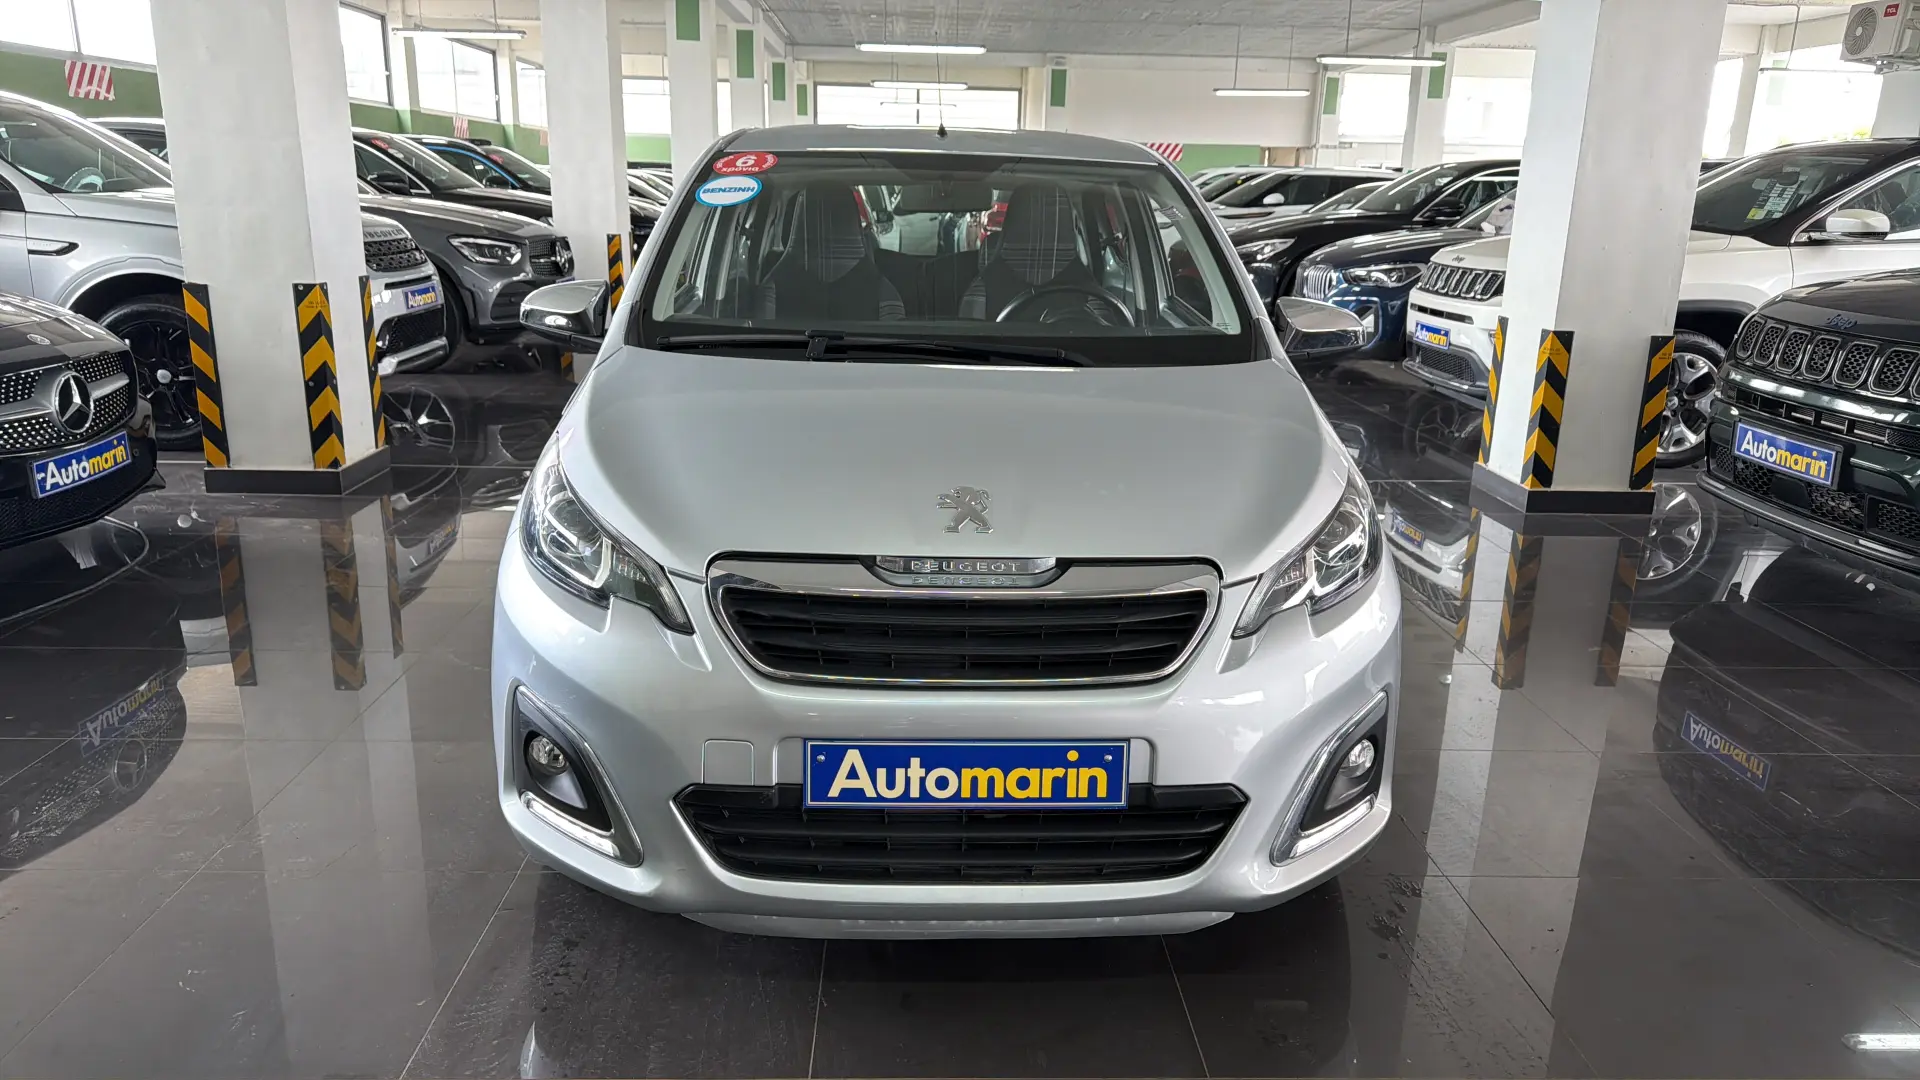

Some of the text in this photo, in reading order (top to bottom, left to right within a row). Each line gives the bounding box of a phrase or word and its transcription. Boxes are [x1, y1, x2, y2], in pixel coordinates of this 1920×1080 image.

[735, 155, 758, 167] 6
[45, 439, 127, 491] Automarin
[1740, 430, 1828, 479] Automarin
[911, 560, 1021, 573] PEUGEOT
[827, 749, 1108, 799] Automarin
